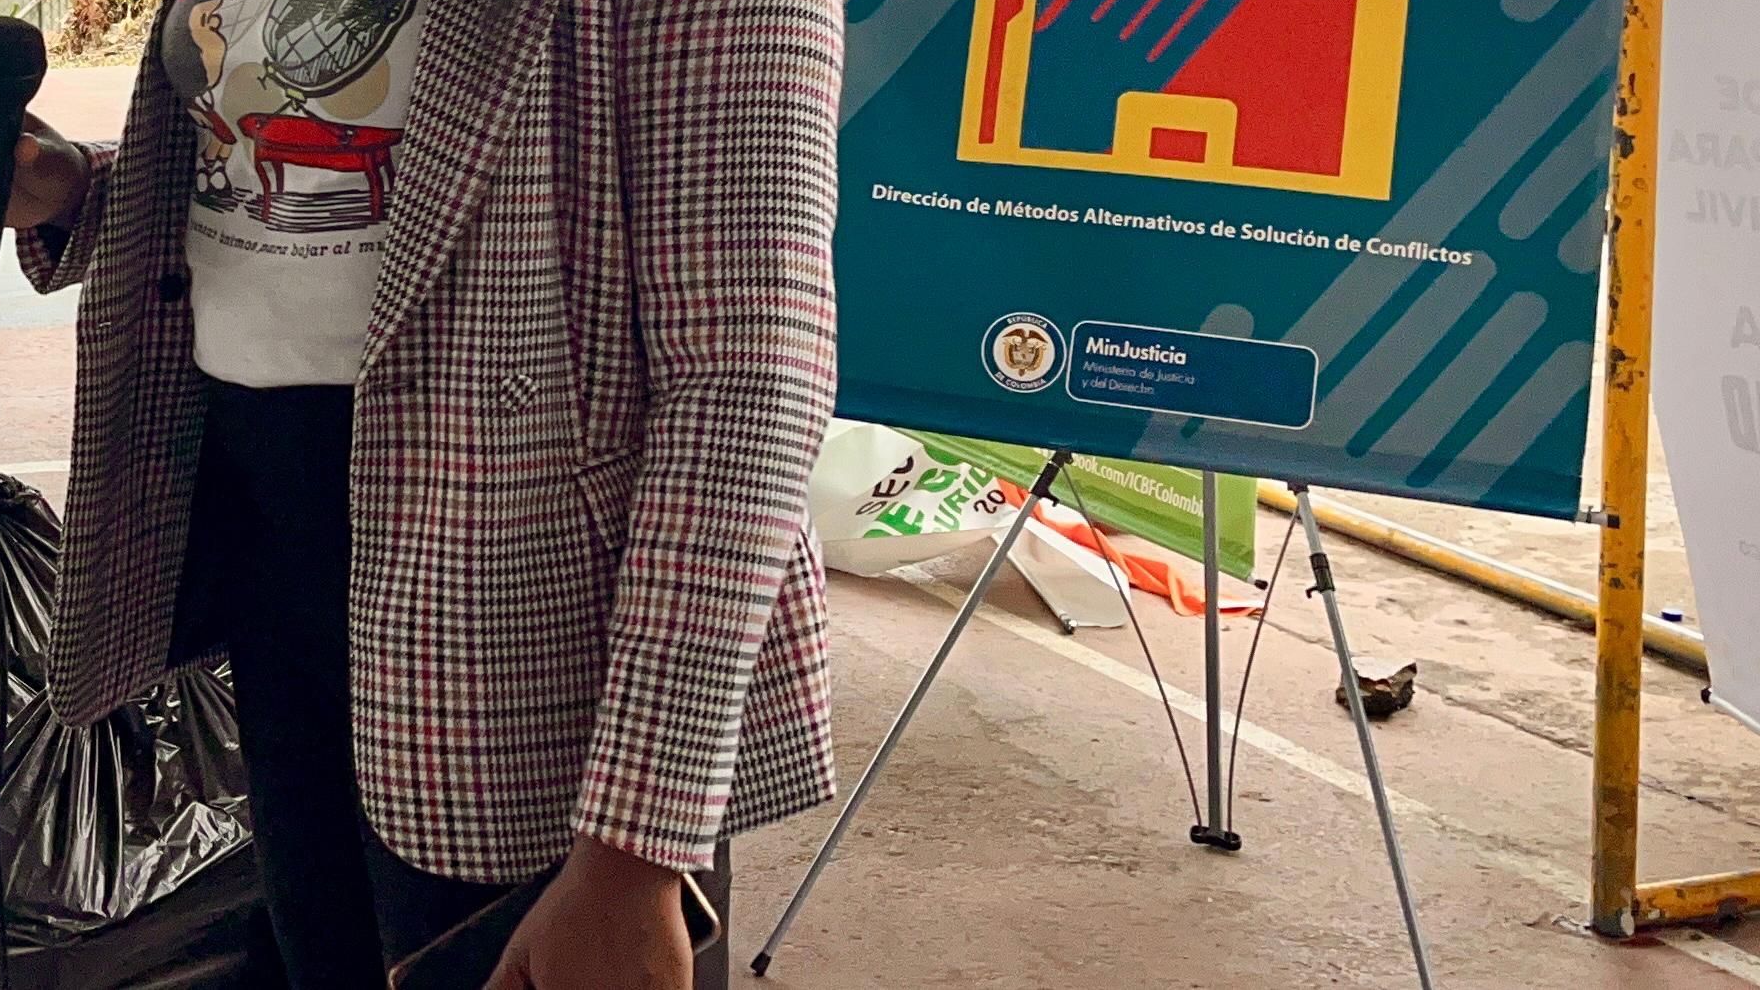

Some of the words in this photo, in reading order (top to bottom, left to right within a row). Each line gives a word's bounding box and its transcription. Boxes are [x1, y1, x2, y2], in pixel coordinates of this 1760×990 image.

[872, 183, 962, 211] Dirección
[966, 197, 991, 215] de
[994, 200, 1079, 223] Métodos
[1083, 207, 1206, 235] Alternativos
[1210, 219, 1236, 239] de
[1240, 223, 1329, 249] Solución
[1335, 233, 1361, 252] de
[1366, 237, 1473, 266] Conflictos
[290, 242, 329, 259] bajar
[332, 240, 351, 255] al
[1085, 336, 1187, 366] MinJusticia
[1081, 378, 1090, 389] y
[1090, 376, 1107, 390] del
[1108, 378, 1155, 395] Derecho
[1082, 361, 1137, 378] Ministerio
[1139, 367, 1155, 380] de
[1155, 369, 1196, 386] Justicia
[1072, 454, 1203, 519] ook.com/ICBFColombi
